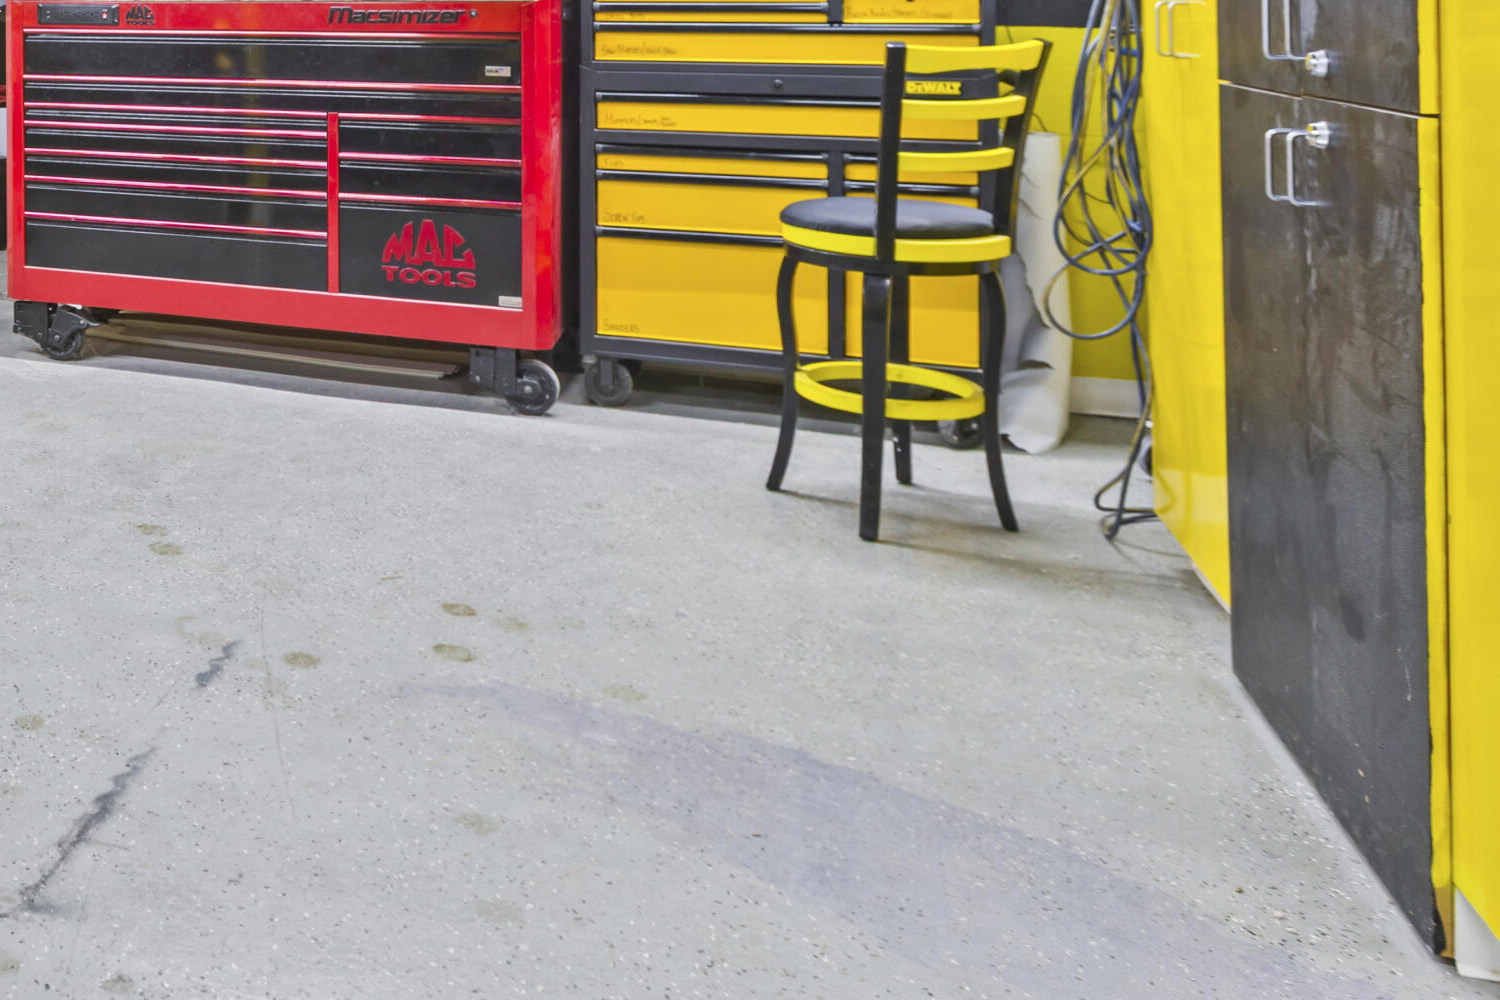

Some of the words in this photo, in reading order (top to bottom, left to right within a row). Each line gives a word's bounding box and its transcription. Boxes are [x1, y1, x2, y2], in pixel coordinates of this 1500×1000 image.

[328, 6, 466, 24] Macsimizer
[381, 219, 477, 270] MAC
[381, 265, 477, 289] TOOLS
